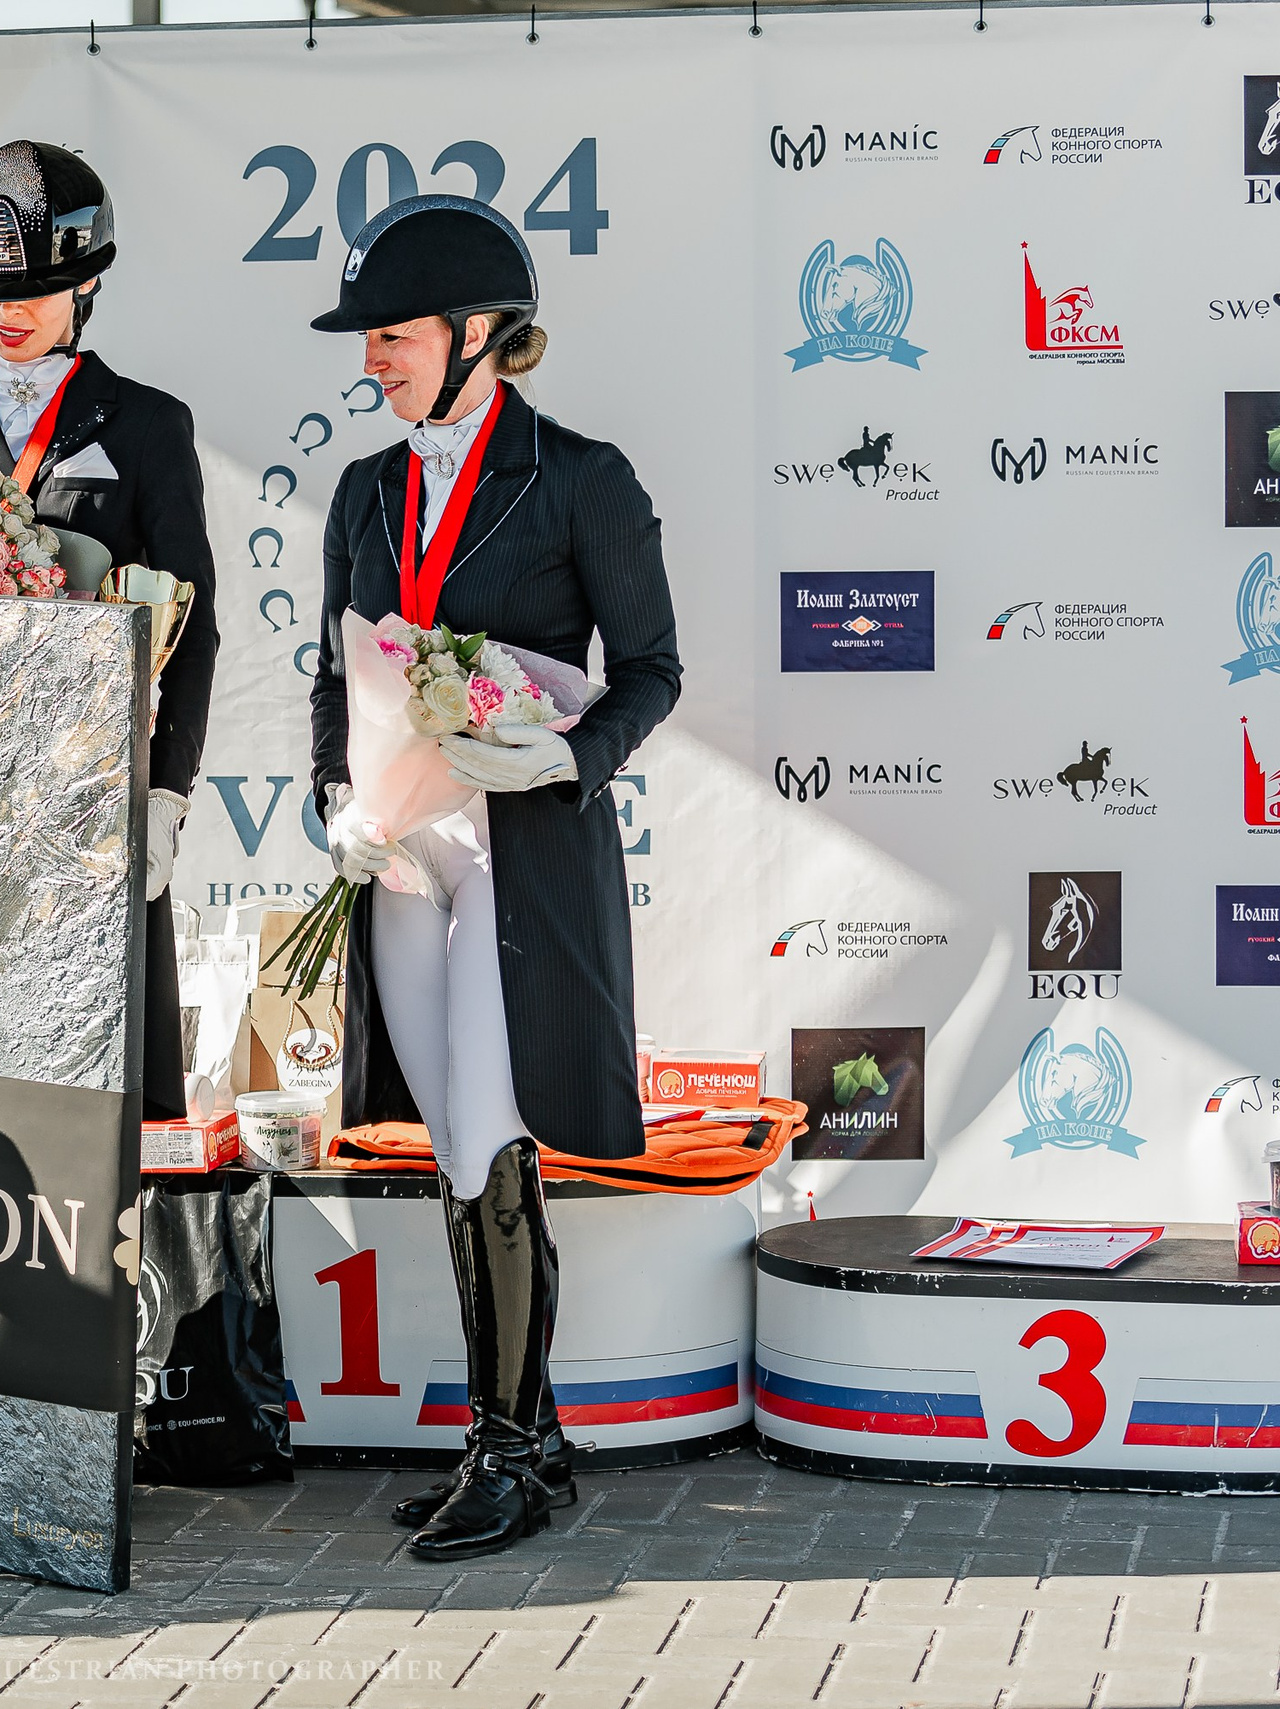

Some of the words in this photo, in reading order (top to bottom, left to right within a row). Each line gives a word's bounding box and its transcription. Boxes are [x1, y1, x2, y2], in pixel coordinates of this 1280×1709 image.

[845, 124, 938, 151] MANÍC
[1051, 126, 1125, 139] ФЕДЕРАЦИЯ
[1051, 139, 1112, 151] КОННОГО
[1114, 139, 1163, 150] СПОРТА
[1051, 153, 1103, 164] РОССИИ
[1050, 325, 1120, 343] ФКСМ
[1066, 437, 1159, 464] MANÍC
[885, 489, 940, 501] Product
[1054, 603, 1127, 616] ФЕДЕРАЦИЯ
[1055, 616, 1114, 628] КОННОГО
[1116, 616, 1164, 627] СПОРТА
[1055, 630, 1105, 641] РОССИИ
[849, 757, 942, 784] MANÍC
[1103, 803, 1158, 816] Product
[837, 922, 911, 933] ФЕДЕРАЦИЯ
[837, 935, 897, 945] КОННОГО
[899, 935, 948, 945] СПОРТА
[837, 948, 888, 958] РОССИИ
[1028, 973, 1123, 1000] EQU
[288, 1079, 332, 1088] ZABEGINA
[820, 1111, 898, 1129] АНИЛИН
[256, 1125, 292, 1140] Лизунец
[314, 1249, 401, 1397] 1
[1005, 1309, 1107, 1458] 3
